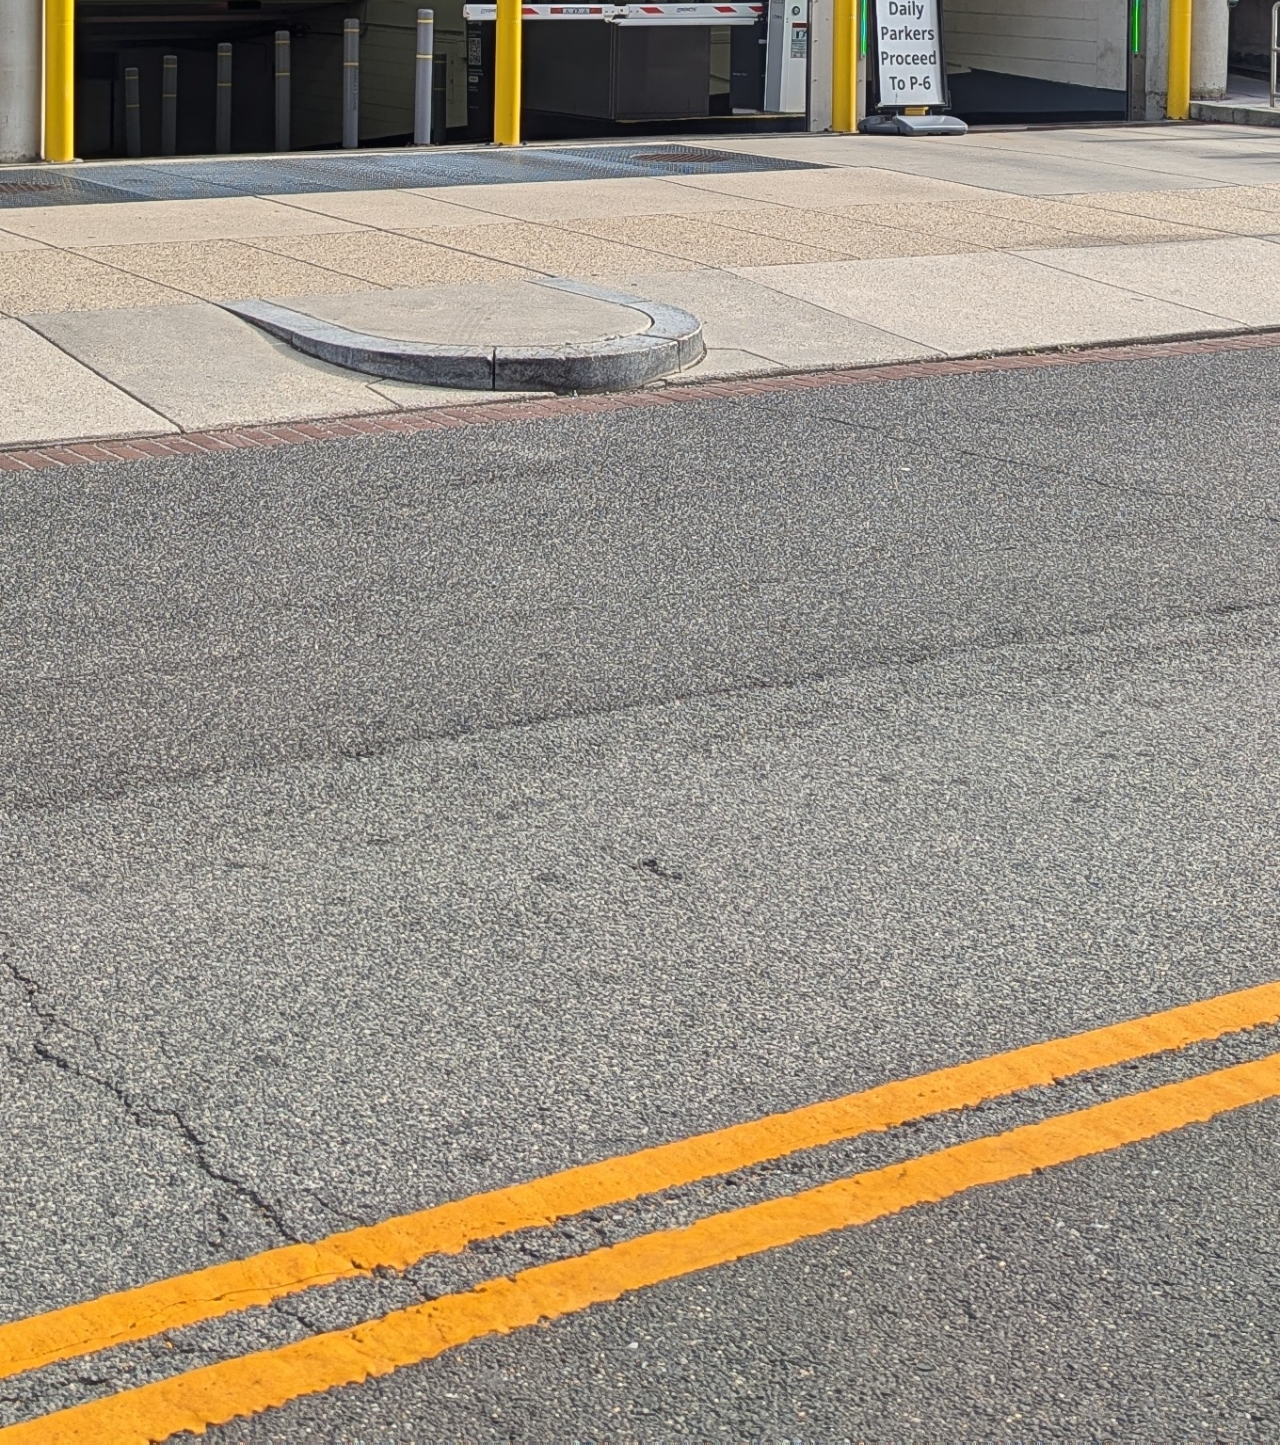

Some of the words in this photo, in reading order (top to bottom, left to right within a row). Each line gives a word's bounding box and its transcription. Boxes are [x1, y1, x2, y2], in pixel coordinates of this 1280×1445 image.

[888, 1, 924, 20] Daily
[881, 26, 935, 41] Parkers
[881, 50, 937, 66] Proceed
[889, 76, 906, 90] To
[909, 76, 931, 90] P-6
